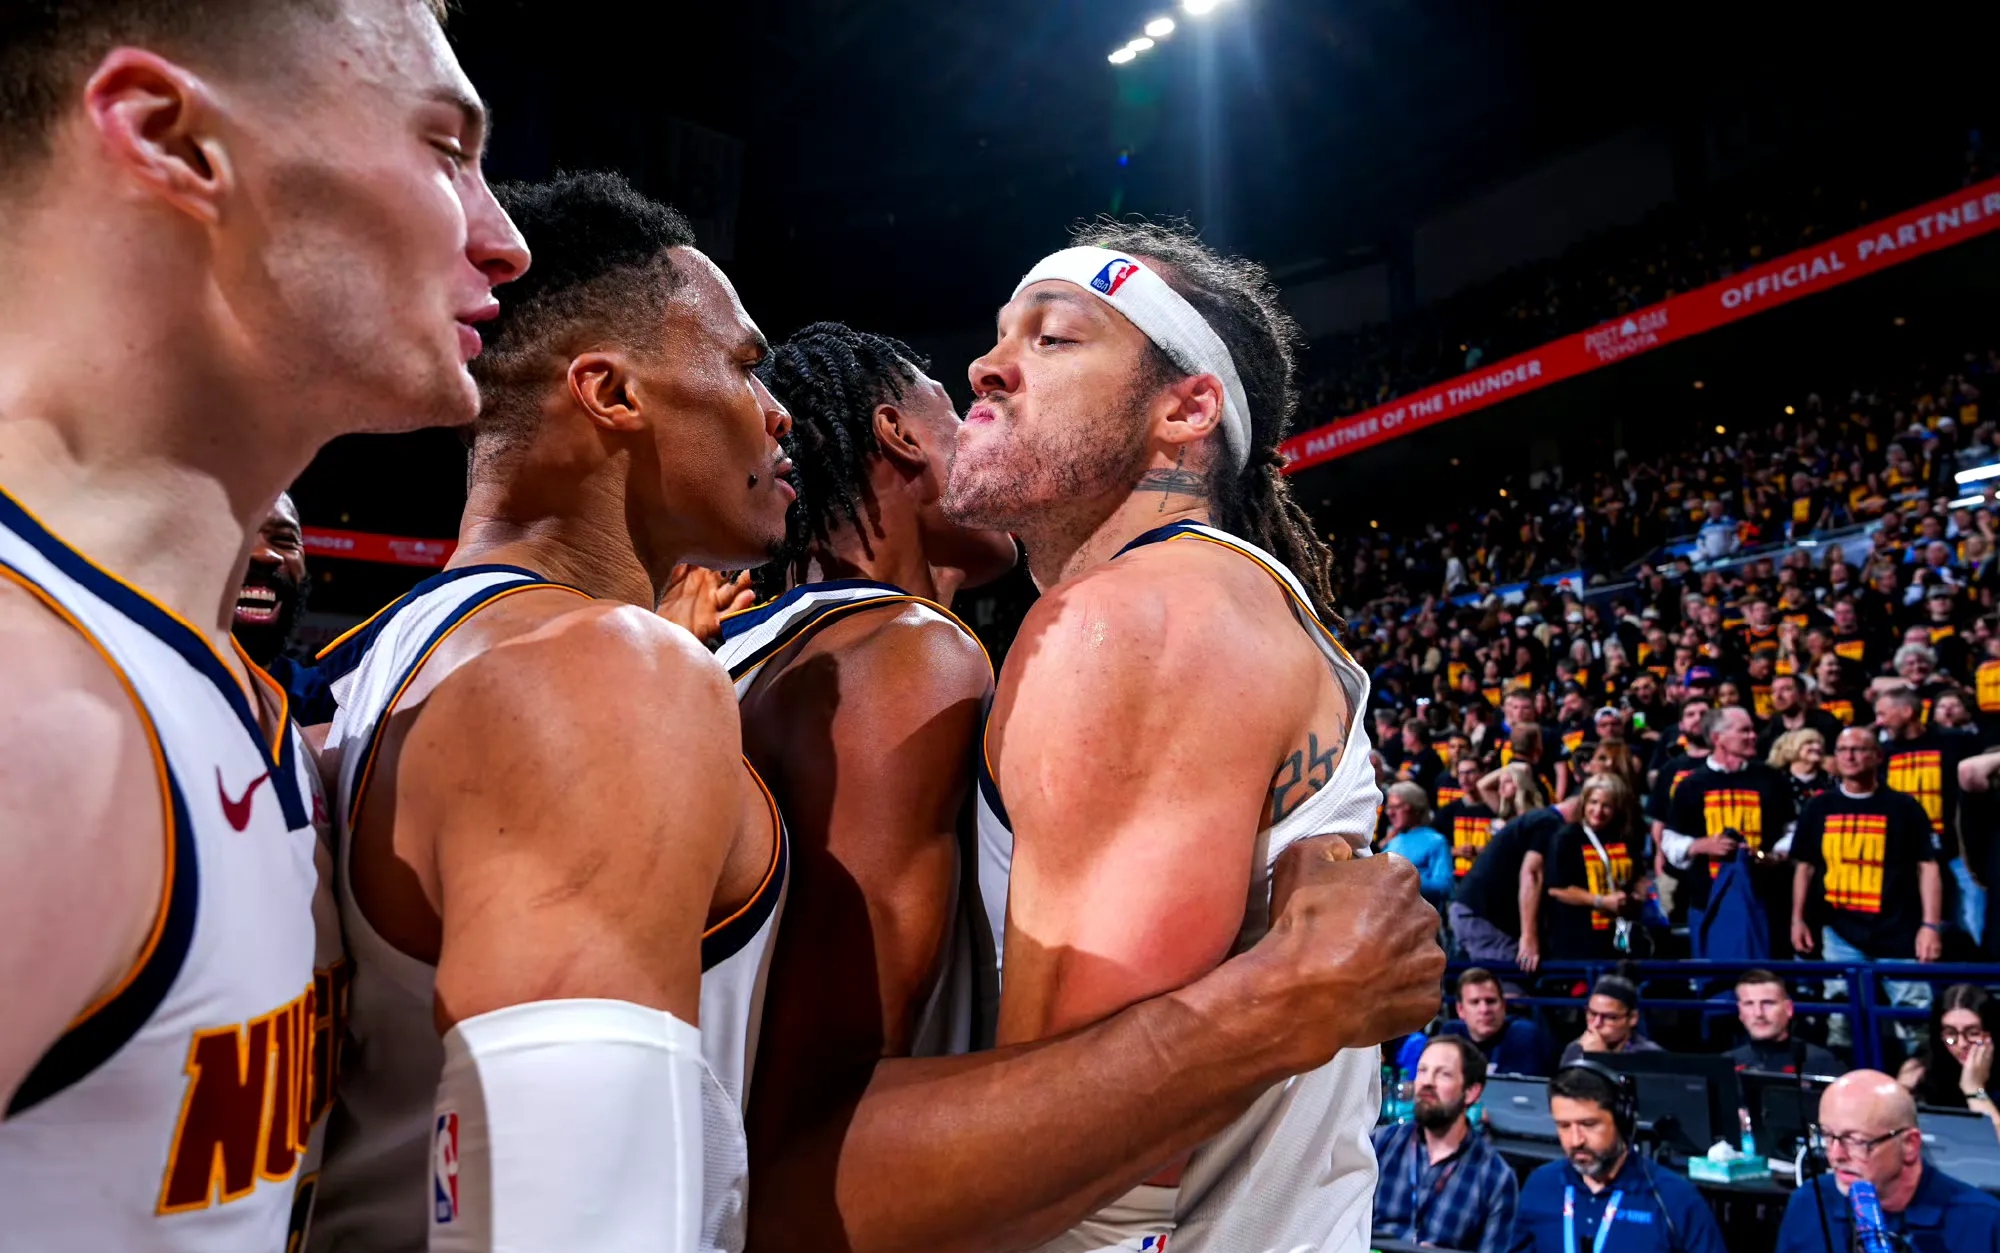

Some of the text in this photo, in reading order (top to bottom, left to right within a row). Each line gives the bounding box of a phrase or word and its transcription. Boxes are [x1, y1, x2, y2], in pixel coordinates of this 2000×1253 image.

[1721, 191, 2000, 308] OFFICIAL PARTNER
[1092, 277, 1109, 292] NBA
[1597, 332, 1659, 362] TOYOTA
[1305, 417, 1380, 457] PARTNER
[1381, 407, 1406, 430] OF
[1408, 394, 1444, 420] THE
[1447, 359, 1542, 406] THUNDER
